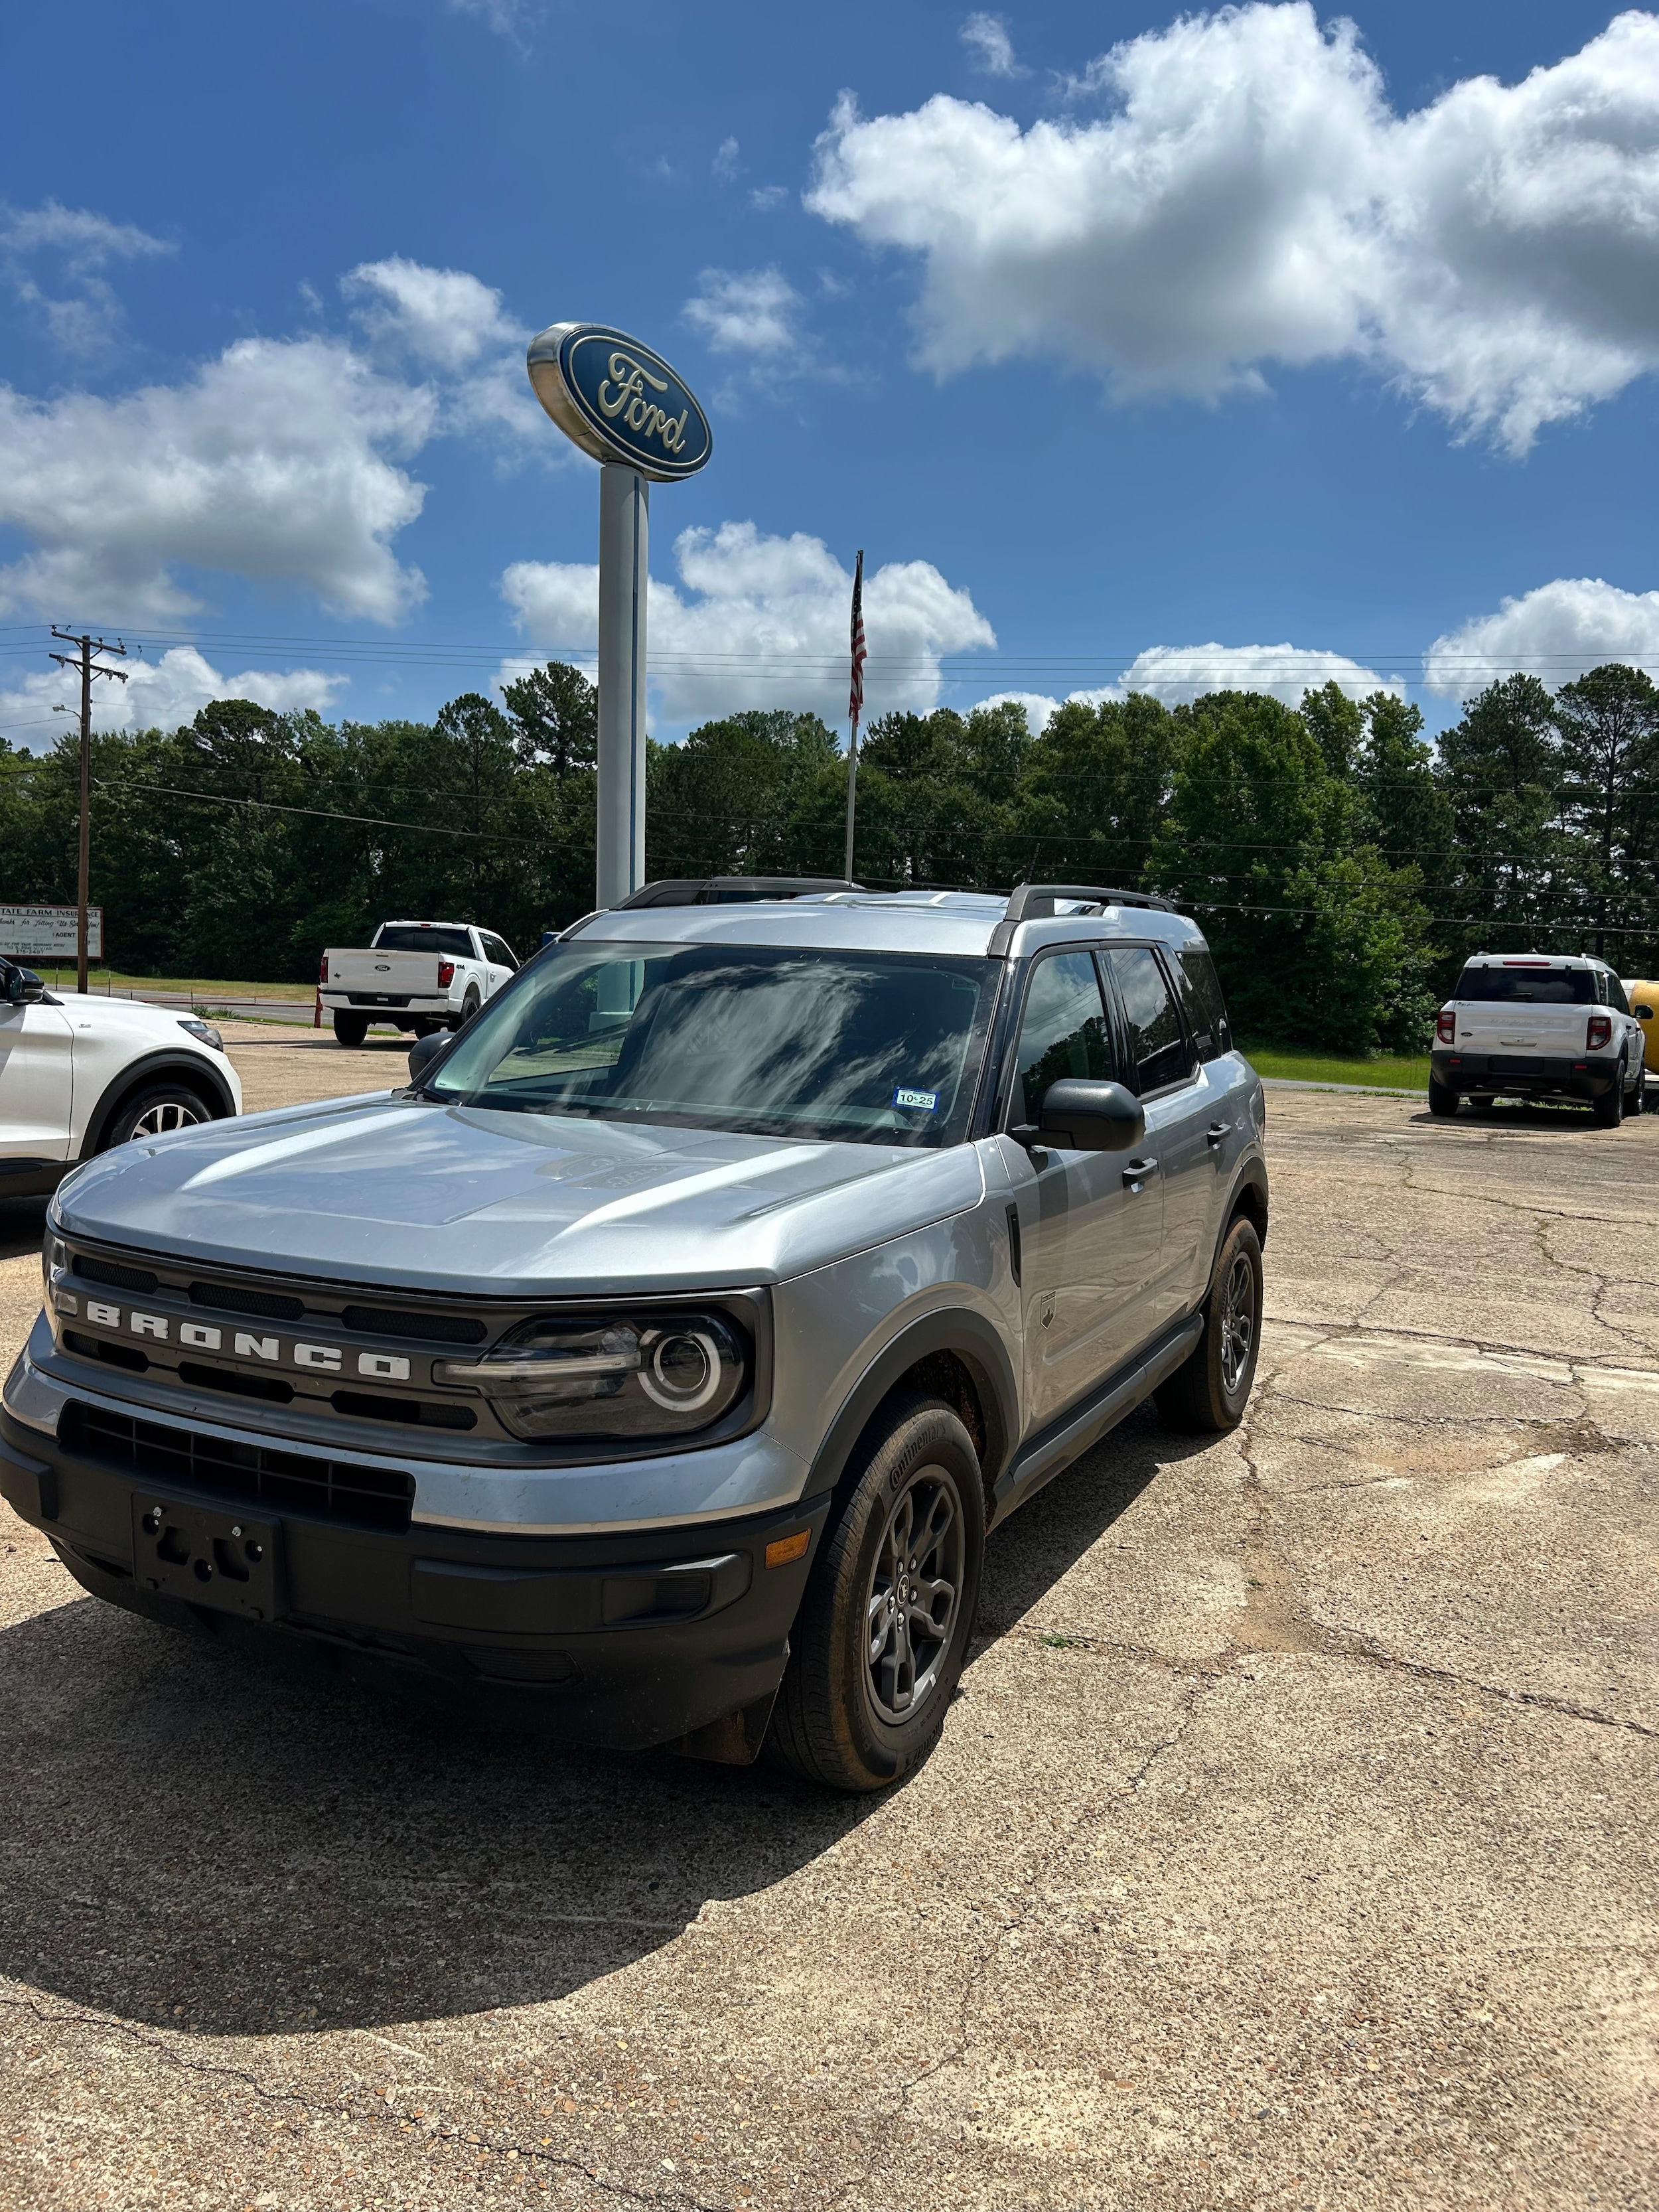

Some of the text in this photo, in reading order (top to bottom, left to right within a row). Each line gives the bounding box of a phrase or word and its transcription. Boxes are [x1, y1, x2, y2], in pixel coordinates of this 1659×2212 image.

[598, 352, 688, 455] Ford
[87, 1301, 410, 1380] BRONCO
[889, 1420, 940, 1493] Continental
